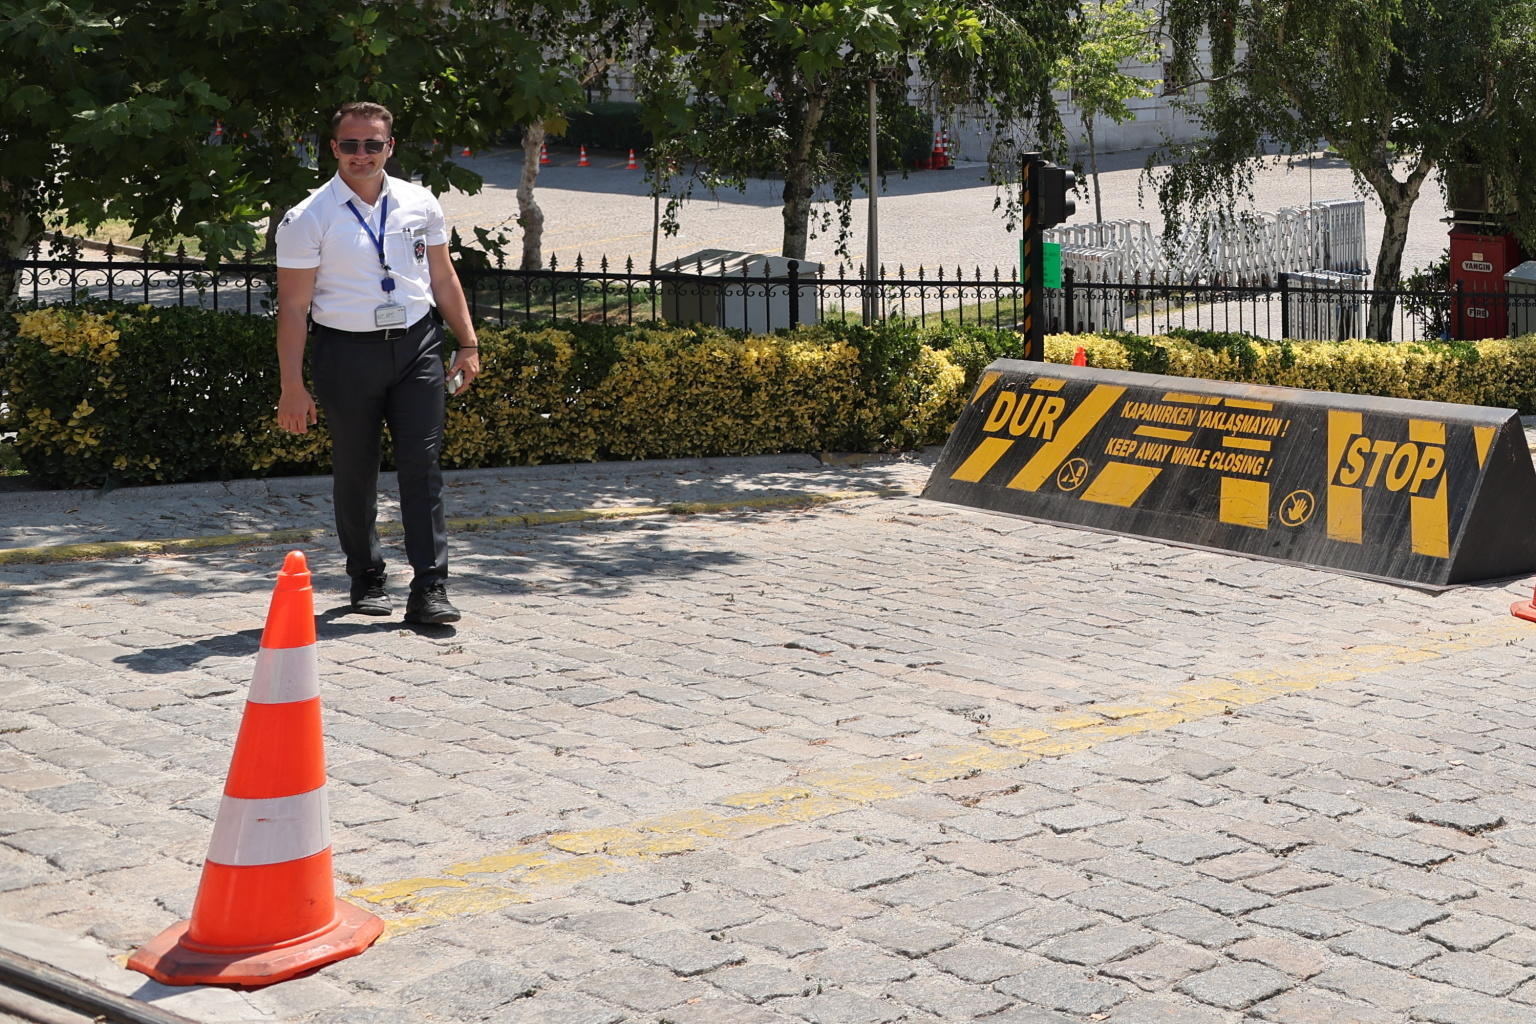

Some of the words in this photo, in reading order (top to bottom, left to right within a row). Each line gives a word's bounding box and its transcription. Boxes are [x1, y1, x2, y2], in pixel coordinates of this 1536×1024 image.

[1464, 262, 1491, 271] YANGIN
[982, 390, 1066, 440] DUR
[1120, 400, 1198, 426] KAPANIRKEN
[1197, 409, 1284, 437] YAKLAŞMAYIN
[1104, 437, 1138, 457] KEEP
[1135, 442, 1172, 462] AWAY
[1170, 445, 1211, 468] WHILE
[1209, 449, 1265, 475] CLOSING
[1340, 436, 1445, 493] STOP
